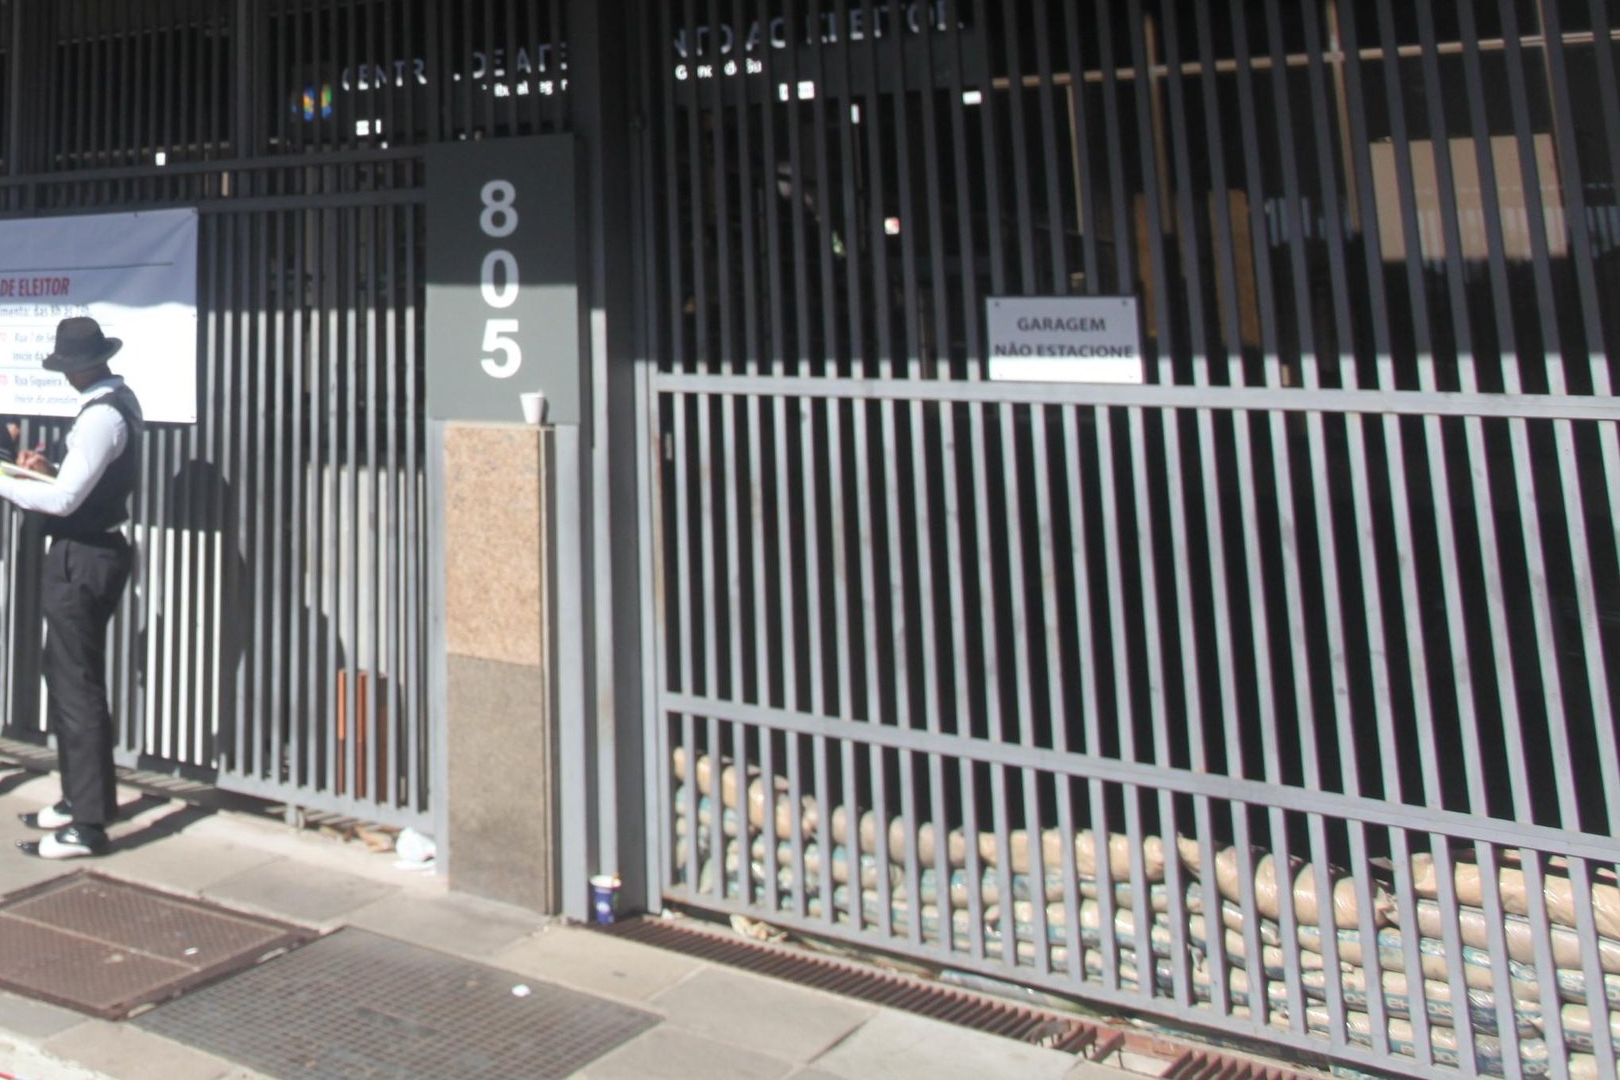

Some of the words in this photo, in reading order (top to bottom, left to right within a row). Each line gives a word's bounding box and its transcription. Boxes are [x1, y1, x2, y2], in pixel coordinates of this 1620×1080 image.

[0, 278, 16, 297] DE
[18, 277, 70, 297] ELEITOR
[479, 179, 522, 379] 805
[1017, 317, 1106, 332] GARAGEM
[994, 341, 1032, 357] NÃO
[1036, 344, 1134, 358] ESTACIONE
